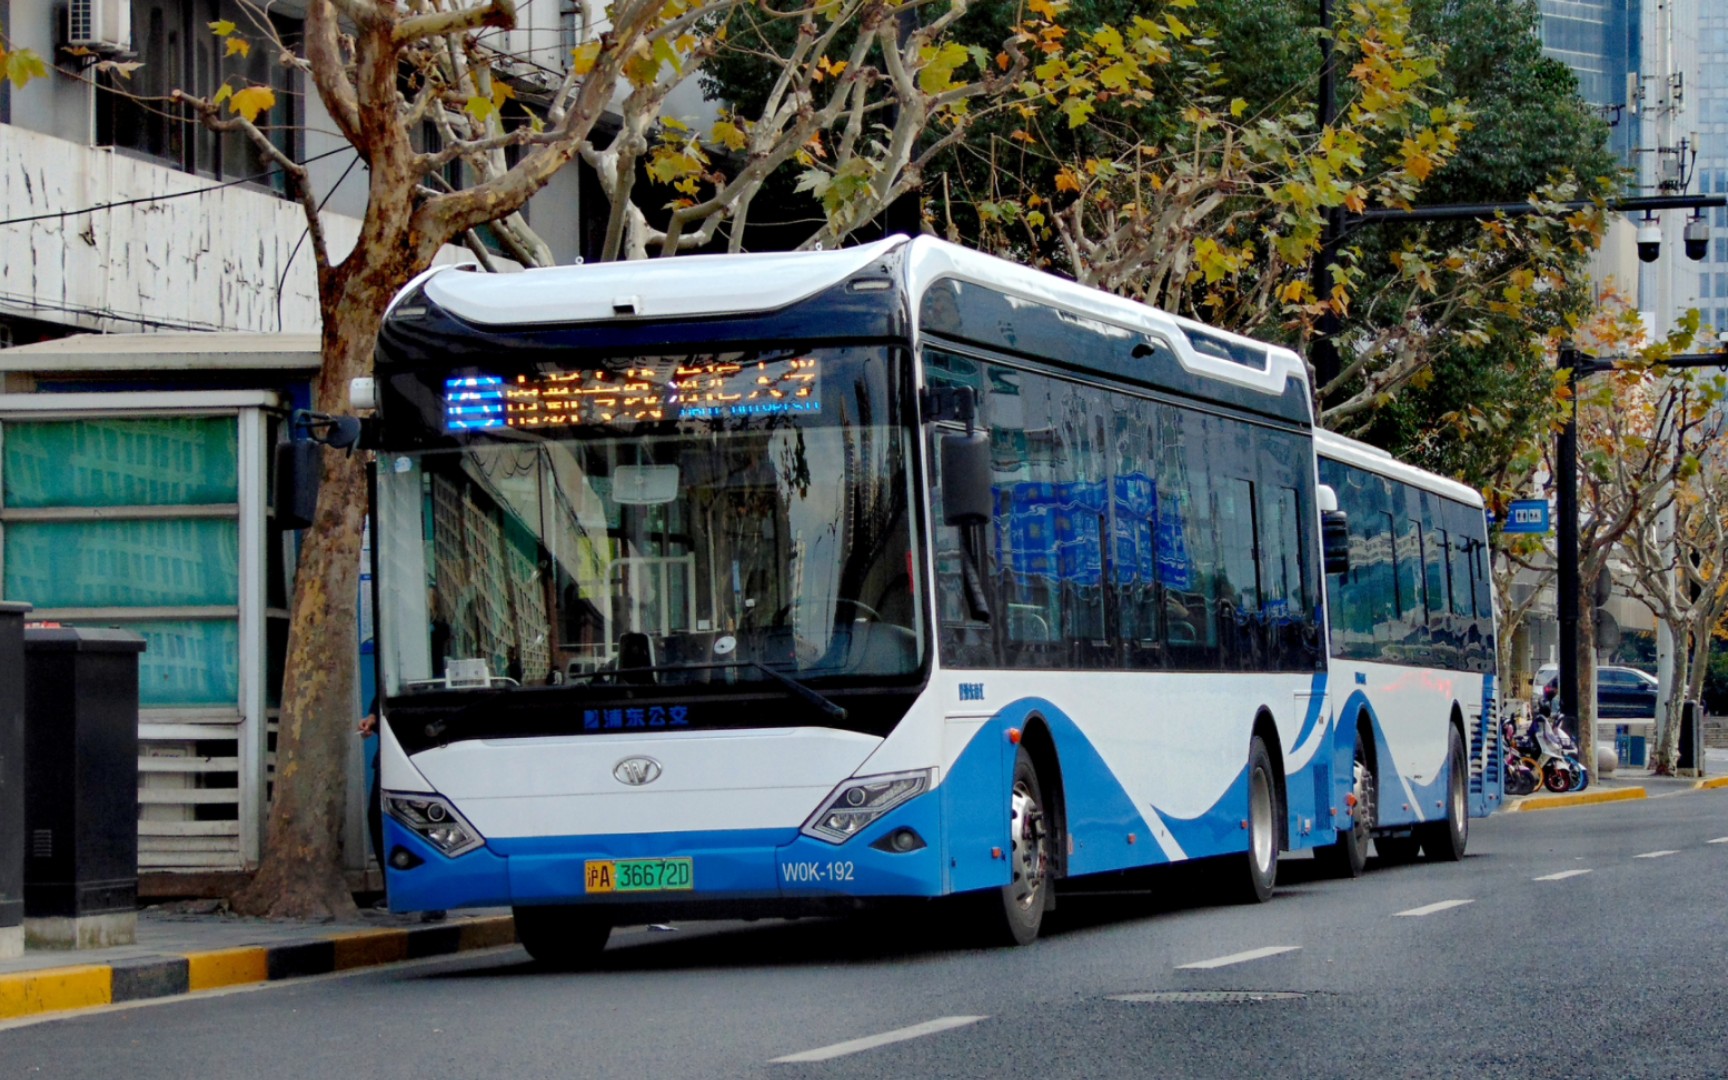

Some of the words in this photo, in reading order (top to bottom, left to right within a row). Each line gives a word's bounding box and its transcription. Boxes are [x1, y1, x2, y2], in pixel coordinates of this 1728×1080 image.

[603, 706, 689, 728] 浦东公交
[620, 861, 689, 887] 36672D
